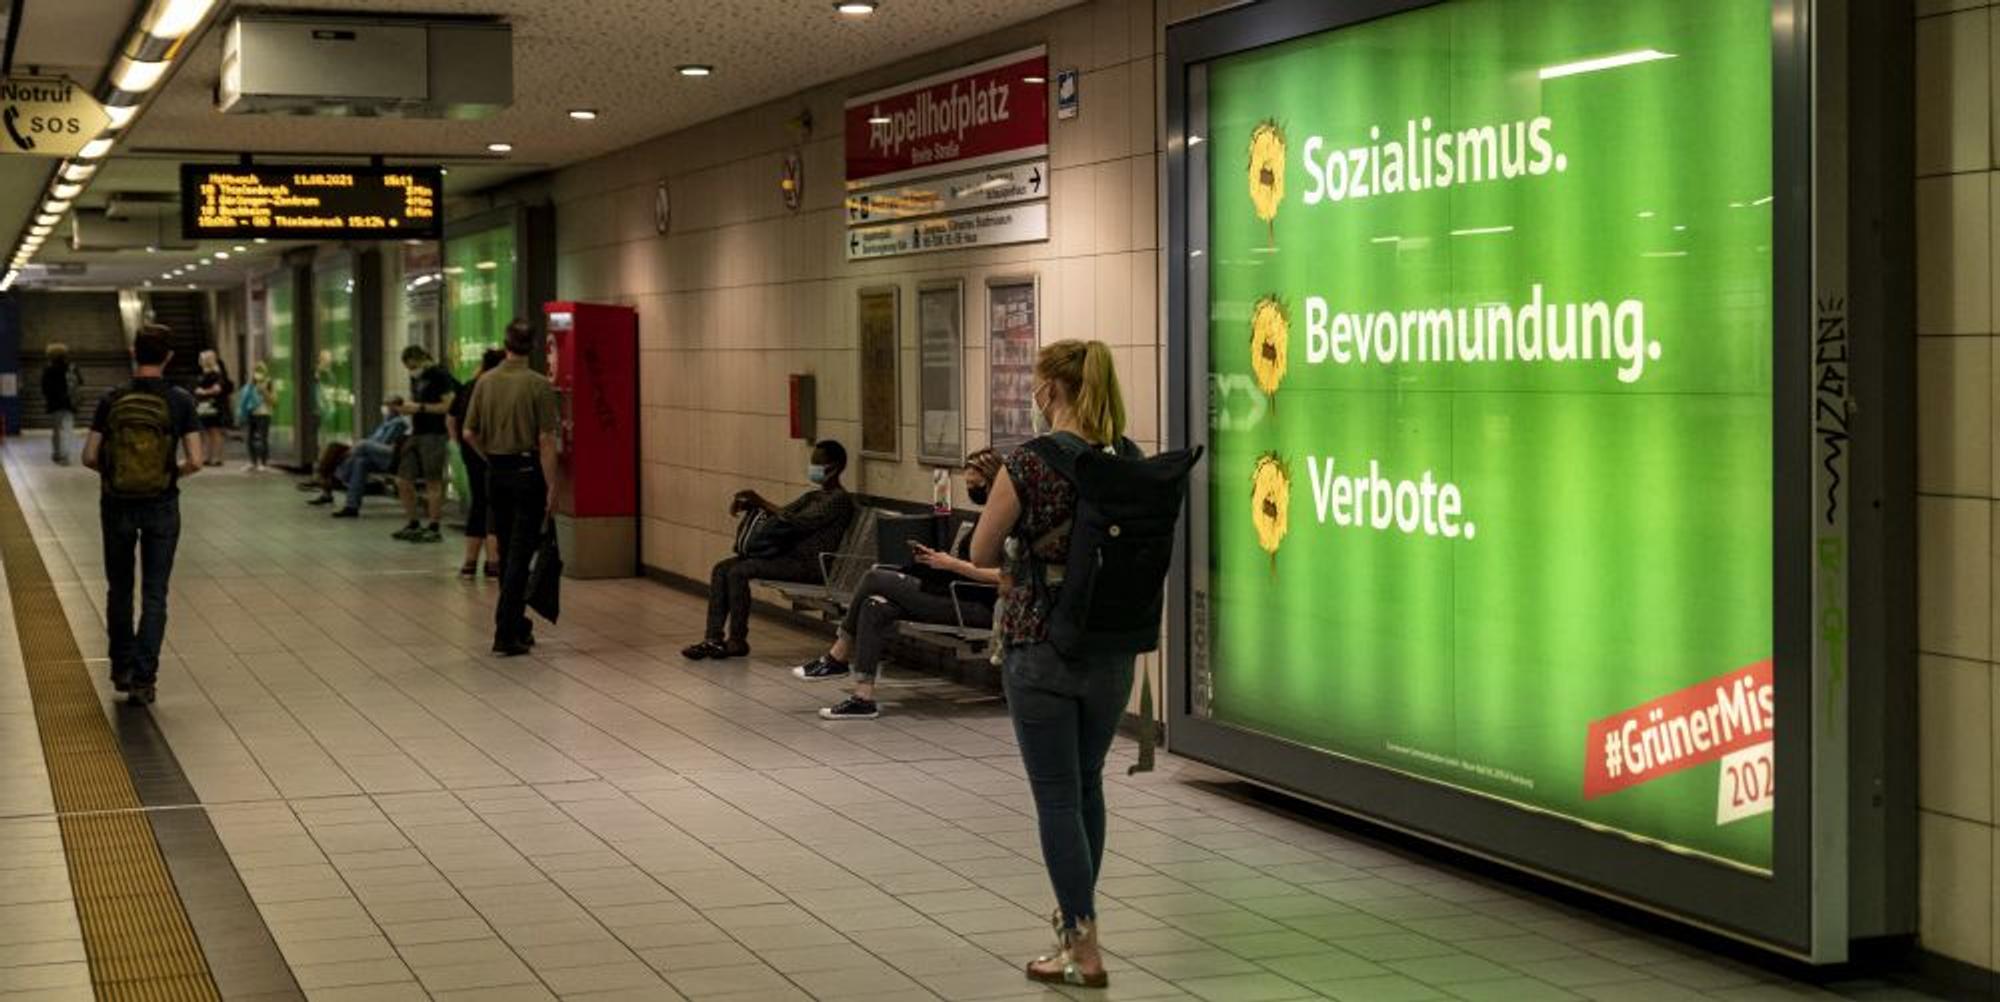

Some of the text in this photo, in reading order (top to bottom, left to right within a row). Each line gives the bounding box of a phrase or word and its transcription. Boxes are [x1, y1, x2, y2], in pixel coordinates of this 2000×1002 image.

[1, 84, 72, 103] Notruf
[31, 116, 80, 133] SOS
[869, 79, 1009, 158] Appellhofplatz
[1303, 116, 1567, 205] Sozialismus.
[1305, 283, 1662, 383] Bevormundung.
[1307, 456, 1475, 540] Verbote.
[1604, 675, 1773, 779] #GrünerMis
